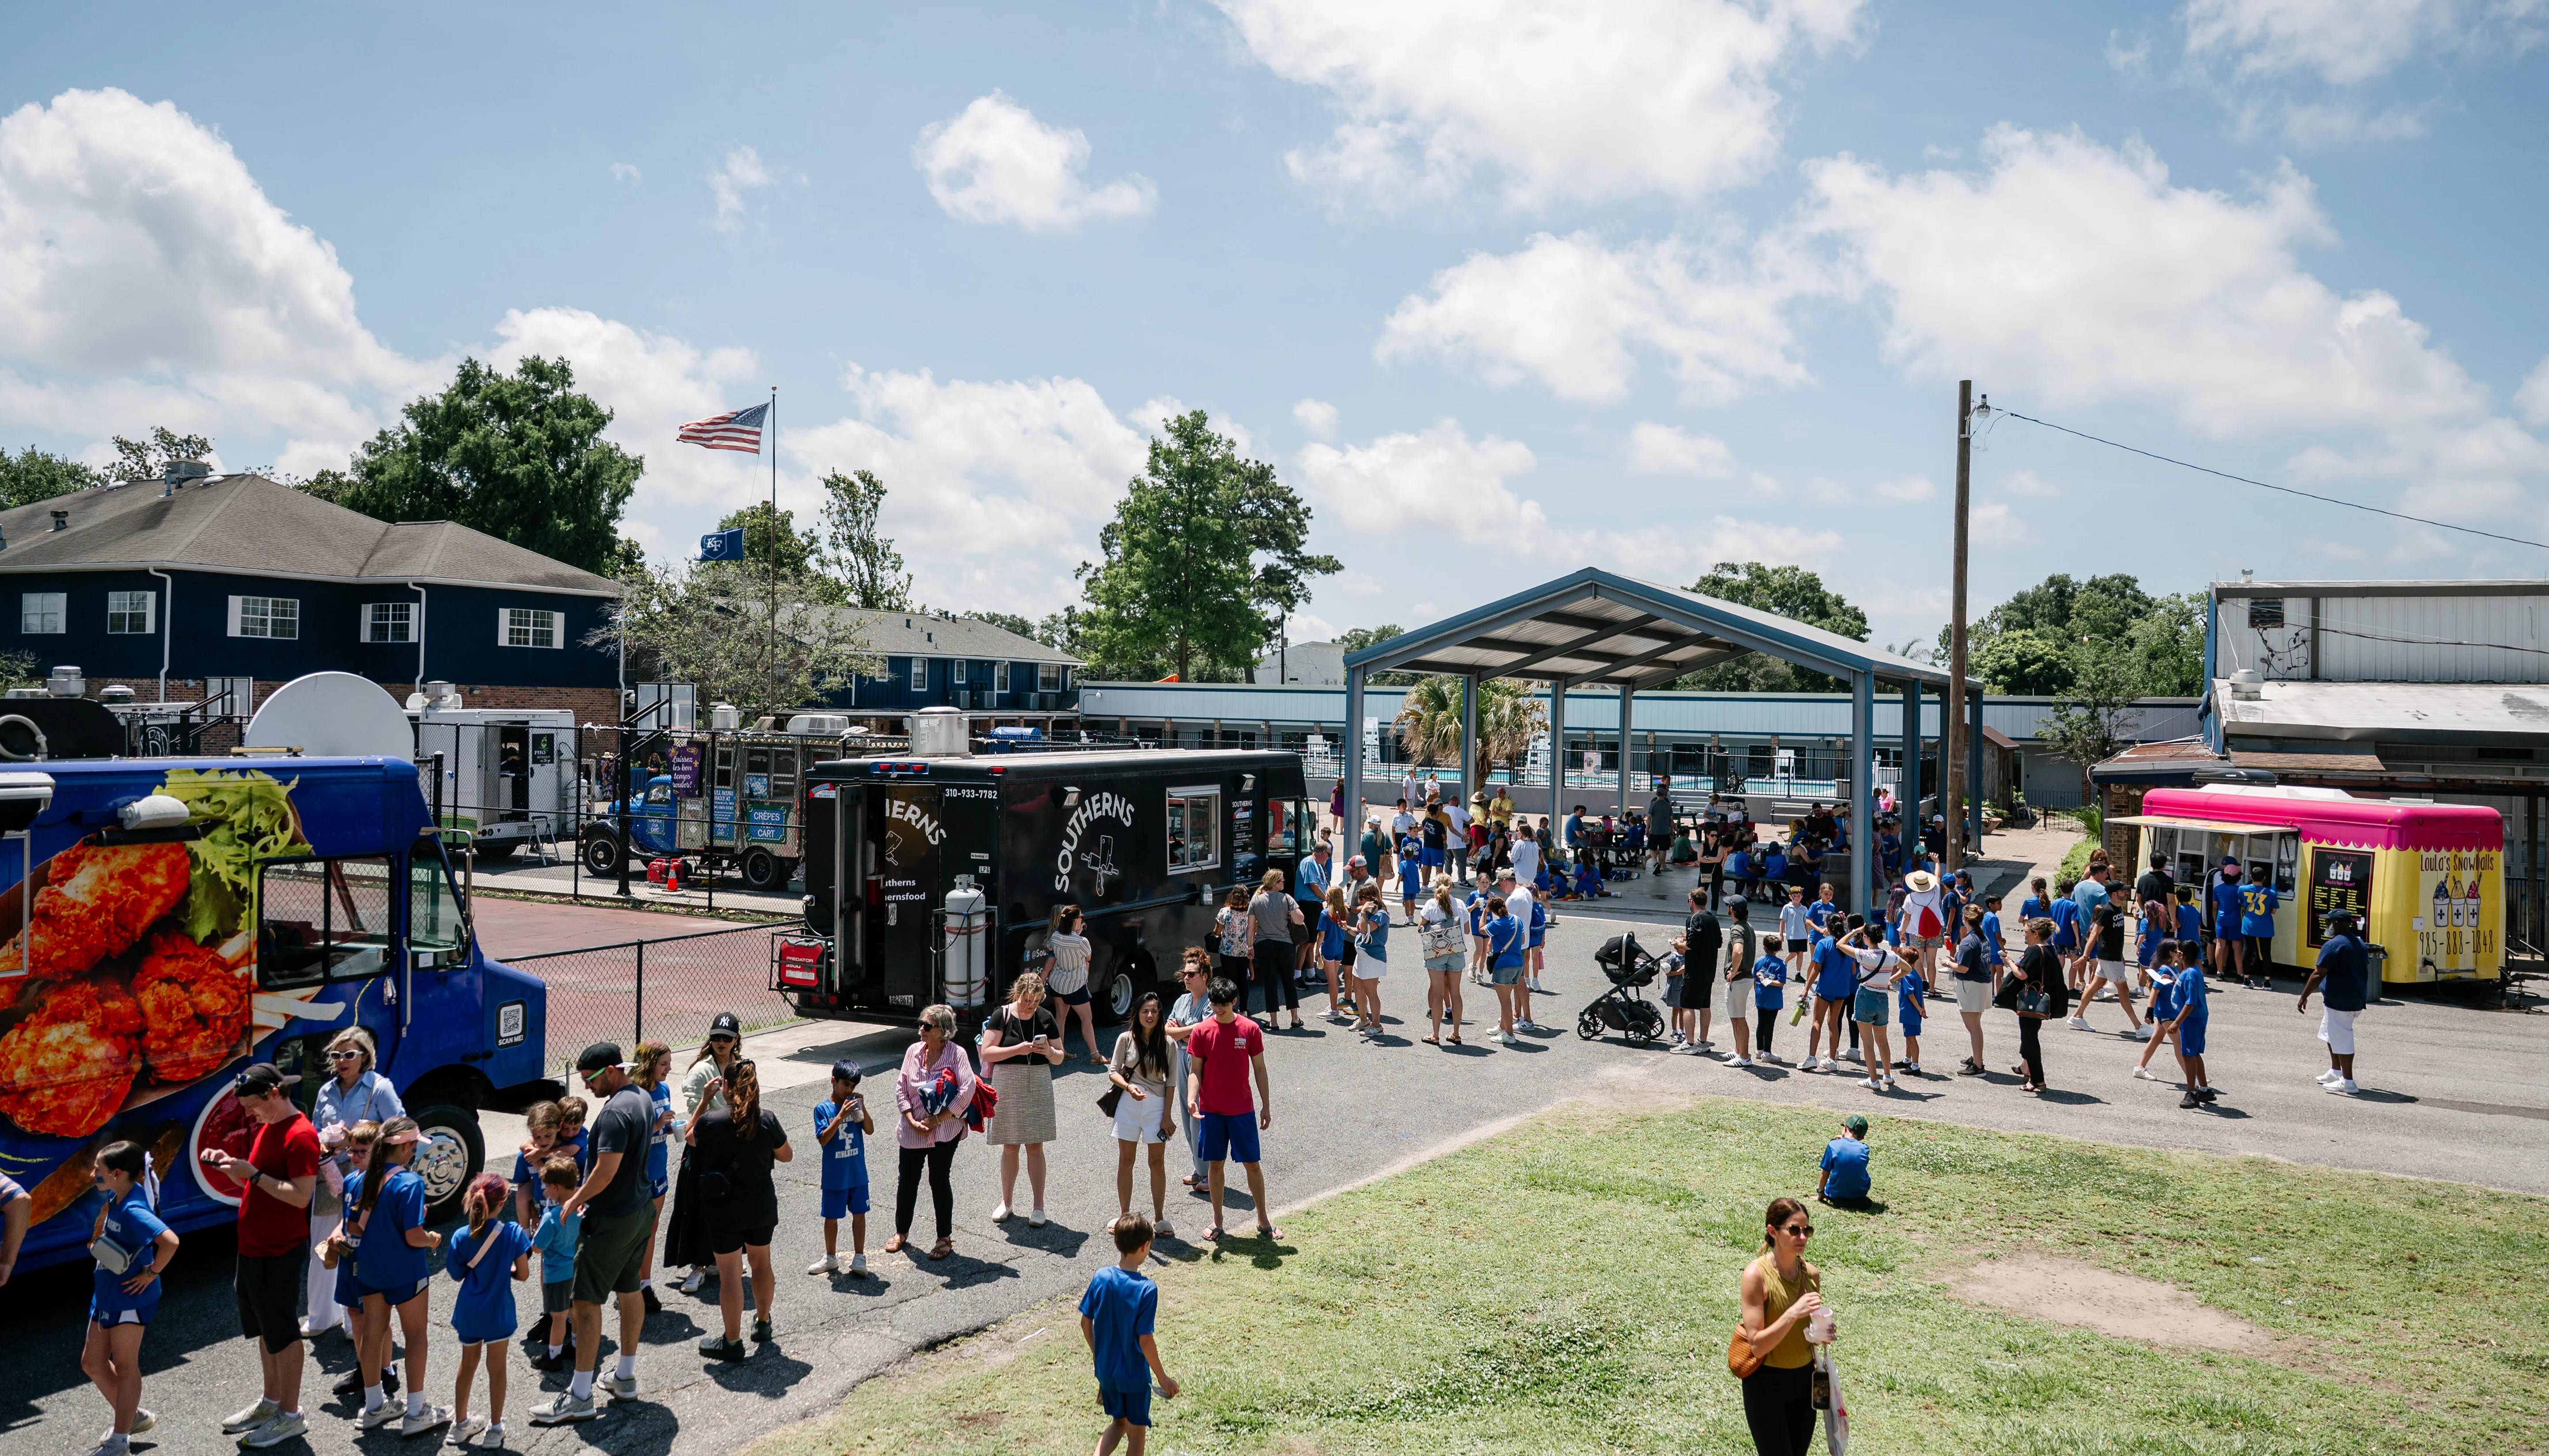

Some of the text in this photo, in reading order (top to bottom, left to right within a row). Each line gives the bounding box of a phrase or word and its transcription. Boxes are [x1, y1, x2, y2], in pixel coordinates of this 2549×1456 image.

[674, 773, 692, 782] temps
[945, 788, 998, 799] 310-933-7782
[753, 811, 780, 821] CRÊPES
[757, 829, 775, 838] CART
[1055, 792, 1135, 893] SOUTHERNS
[2244, 892, 2267, 915] 33
[2420, 929, 2493, 956] 985-888-1848
[498, 1037, 513, 1046] SCAN
